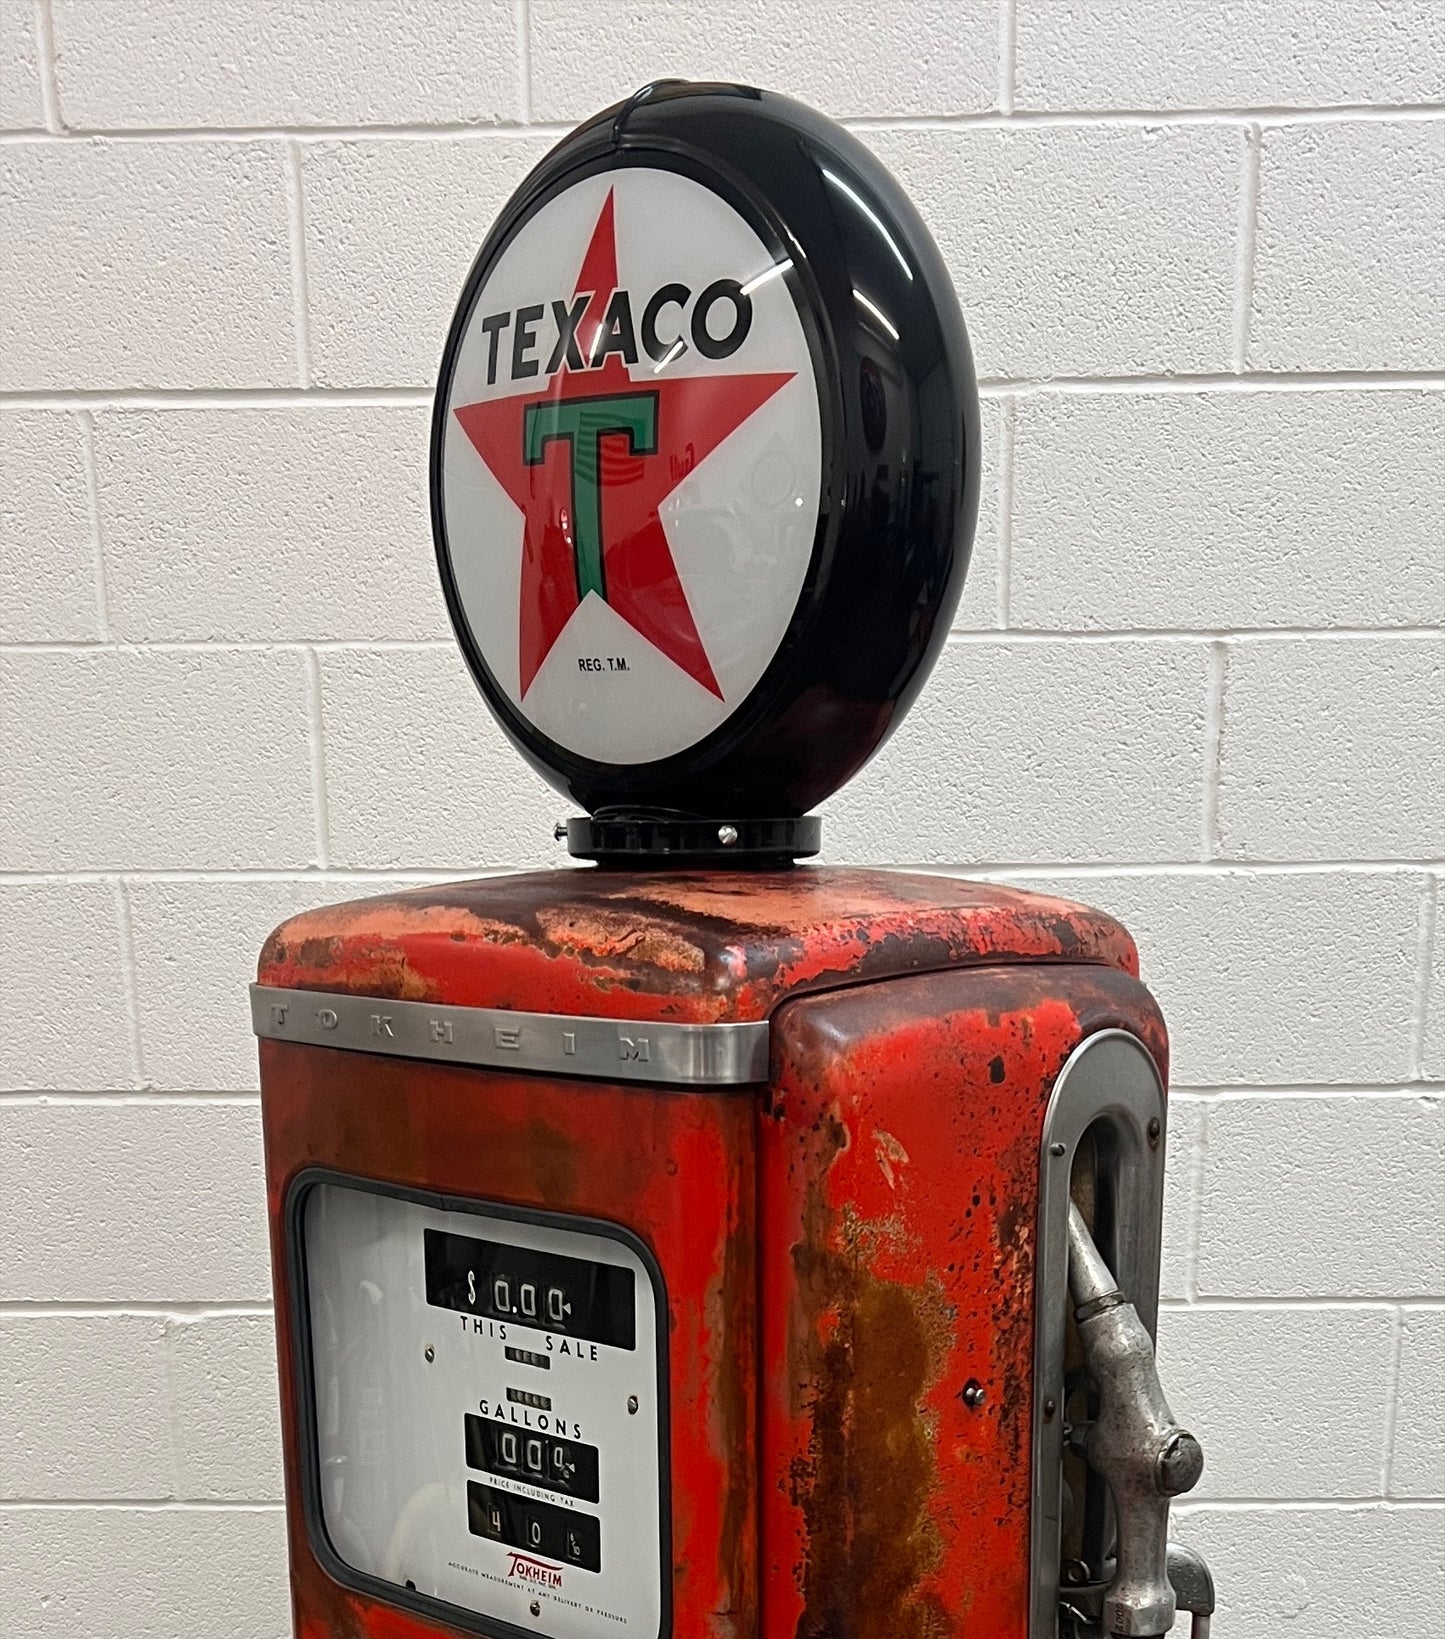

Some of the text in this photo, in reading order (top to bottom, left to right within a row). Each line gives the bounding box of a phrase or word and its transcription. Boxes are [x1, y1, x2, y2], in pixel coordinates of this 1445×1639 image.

[482, 279, 752, 385] TEXACO
[523, 390, 660, 601] T
[578, 658, 630, 671] REG. T.M.
[271, 1005, 650, 1063] TOKHEIM
[460, 1316, 507, 1340] THIS
[546, 1336, 598, 1361] SALE
[479, 1400, 582, 1439] GALLONS
[489, 1477, 574, 1507] PRICE INCLUDING TAX
[506, 1551, 564, 1587] TOKHEIM
